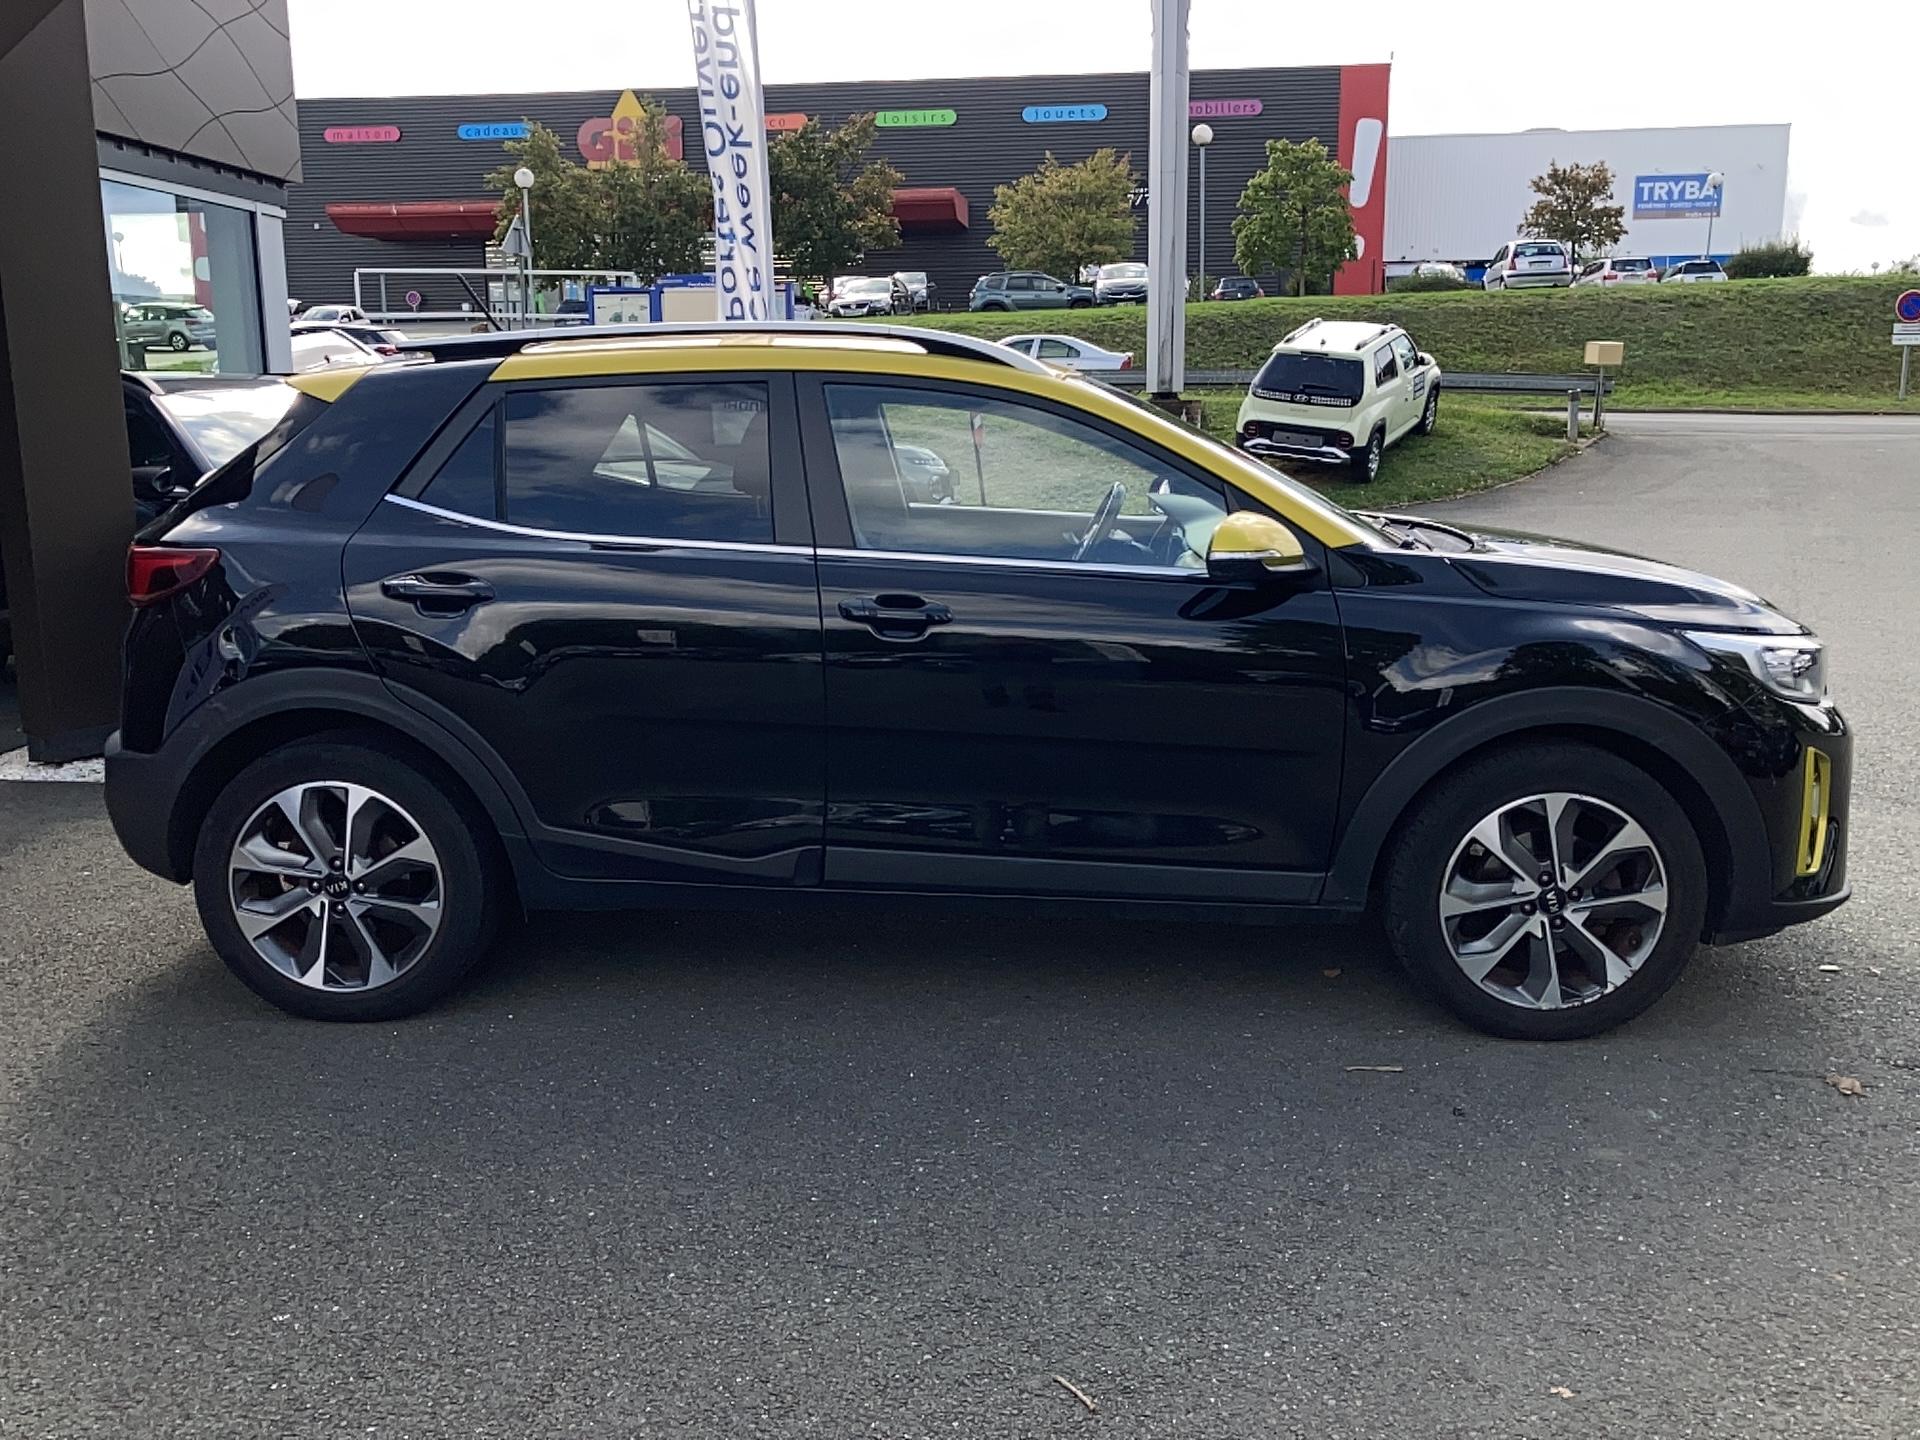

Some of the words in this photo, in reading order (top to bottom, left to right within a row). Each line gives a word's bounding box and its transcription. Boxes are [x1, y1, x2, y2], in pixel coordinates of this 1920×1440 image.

[883, 110, 947, 125] loisirs
[1033, 107, 1097, 121] jouets
[333, 130, 391, 141] maison
[1639, 180, 1718, 201] TRYBA
[1545, 890, 1560, 914] KIA
